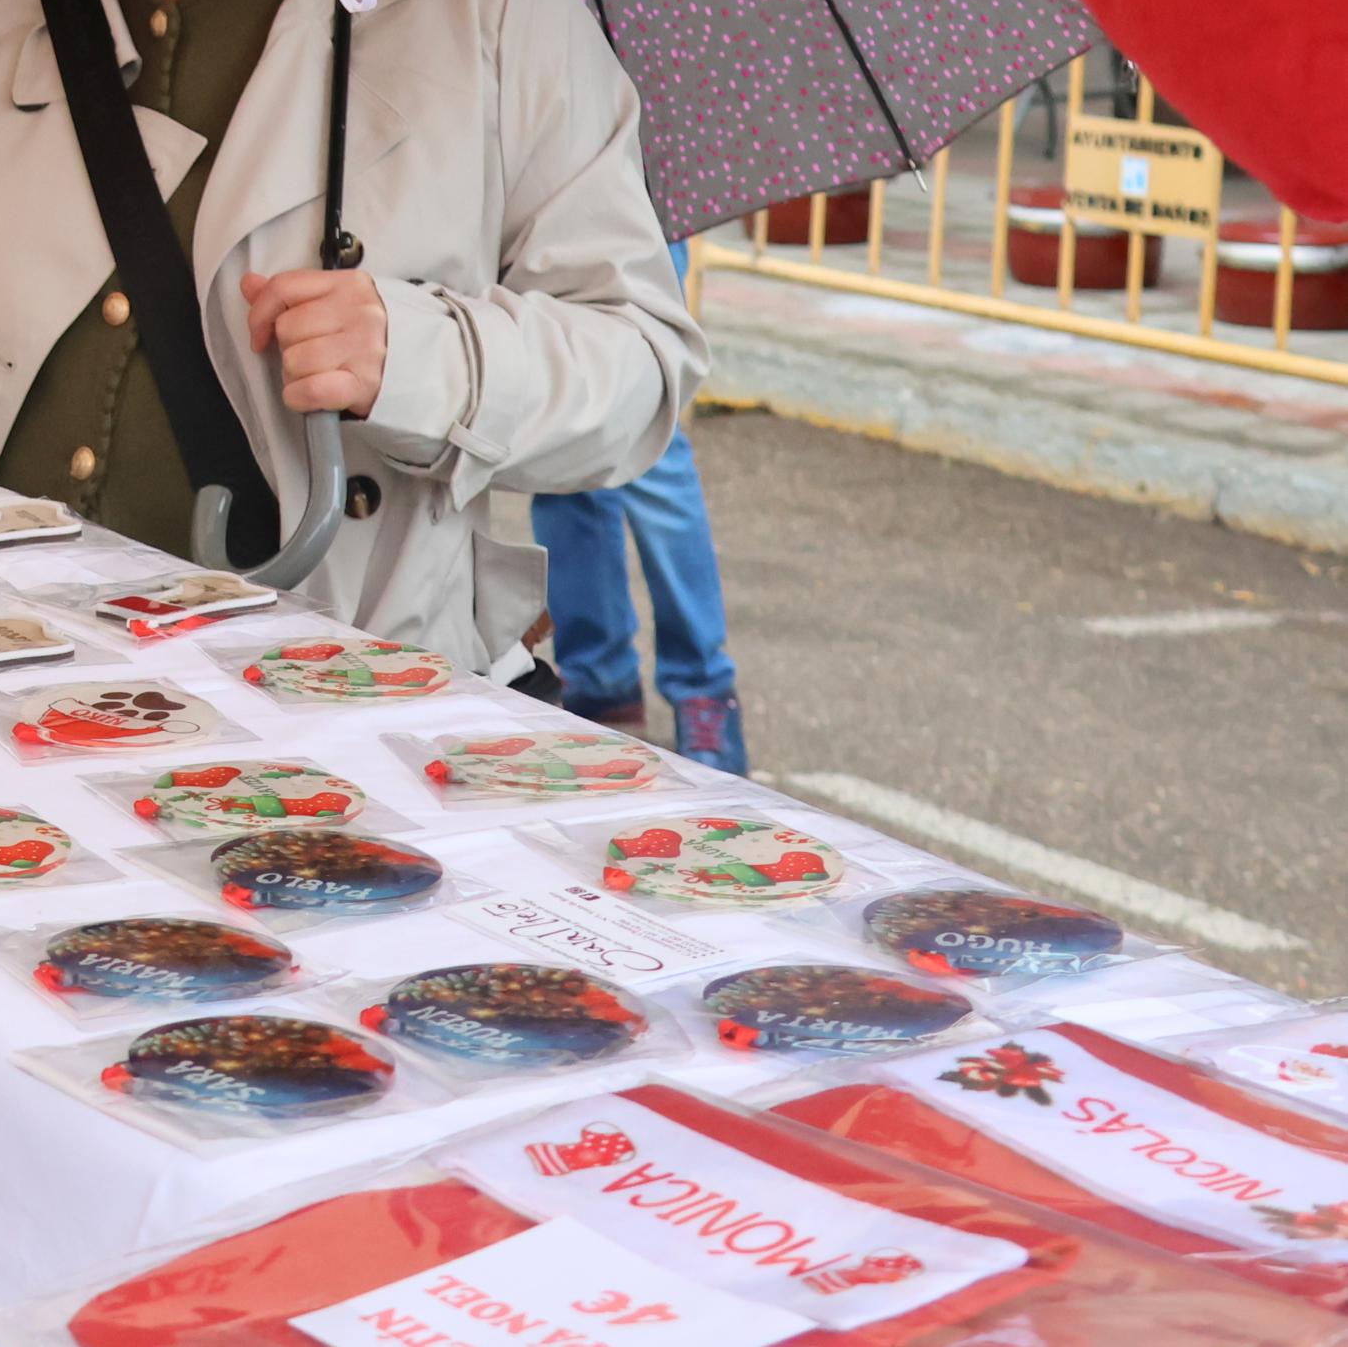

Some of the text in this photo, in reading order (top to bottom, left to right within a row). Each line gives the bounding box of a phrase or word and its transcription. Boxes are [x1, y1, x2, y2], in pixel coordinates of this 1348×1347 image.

[1073, 131, 1203, 160] AYUNTAMIENTO
[1124, 198, 1143, 215] DE
[679, 838, 745, 864] LAURA
[255, 872, 374, 900] PABLO
[934, 932, 1052, 958] HUGO
[756, 1010, 904, 1039] MARTA
[164, 1060, 266, 1101] SARA
[1060, 1097, 1286, 1201] NICOLÁS
[601, 1162, 852, 1277] MÓNICA
[424, 1274, 550, 1335] NOEL
[570, 1289, 680, 1326] 4€
